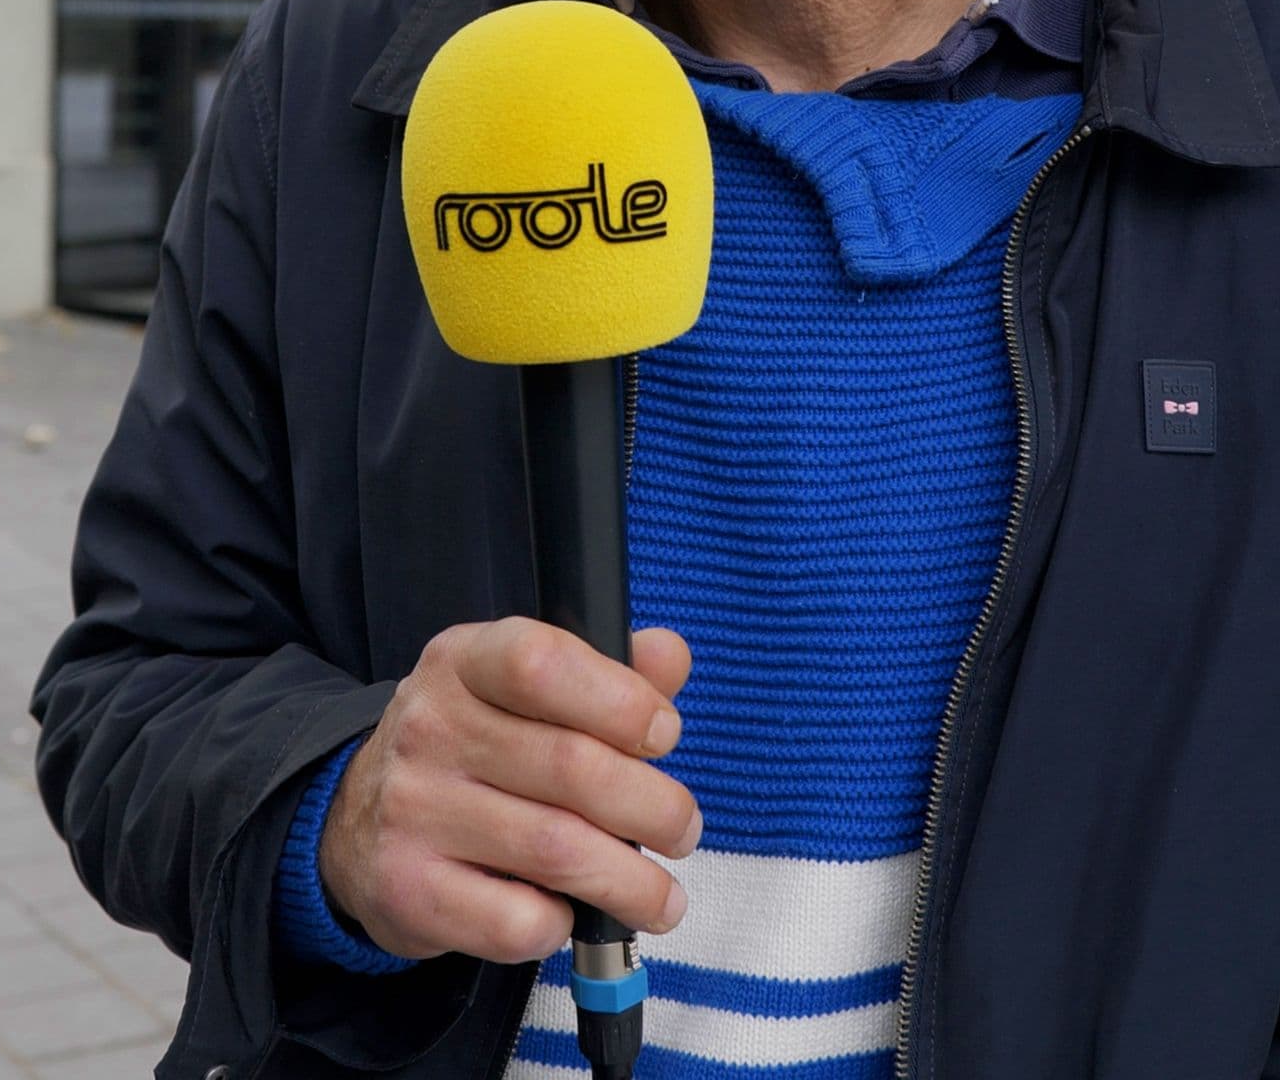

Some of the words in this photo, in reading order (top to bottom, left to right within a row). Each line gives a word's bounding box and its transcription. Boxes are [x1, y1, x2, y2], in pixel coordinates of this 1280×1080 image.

[434, 162, 668, 252] roole
[1160, 377, 1200, 396] Eden
[1161, 417, 1201, 436] Park
